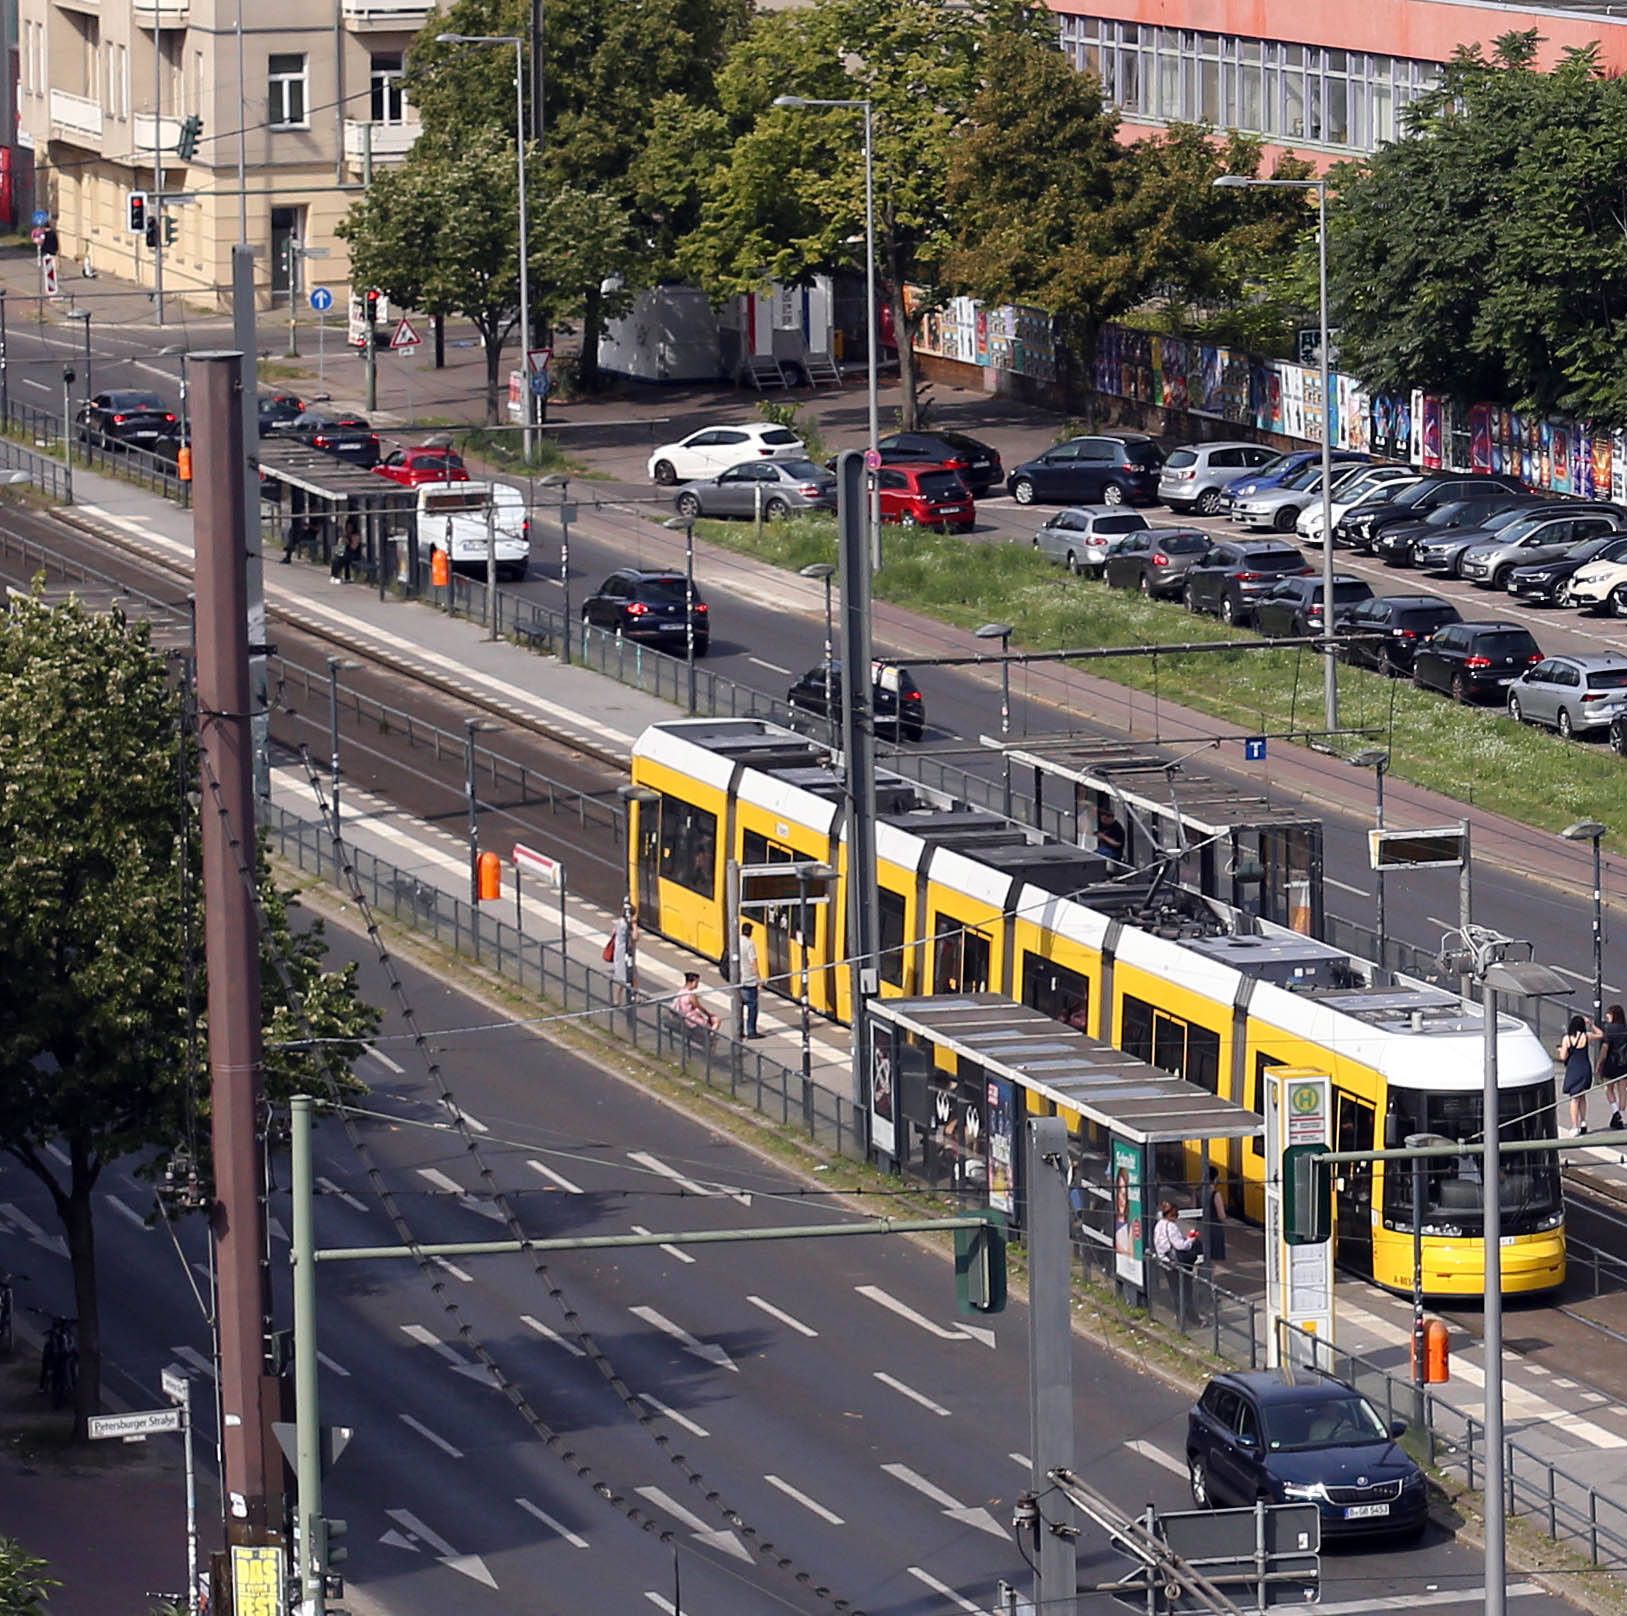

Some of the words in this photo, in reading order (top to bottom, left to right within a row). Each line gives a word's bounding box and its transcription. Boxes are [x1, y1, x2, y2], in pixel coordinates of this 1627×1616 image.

[95, 1419, 147, 1431] Petersburger
[148, 1414, 176, 1427] Straße
[237, 1559, 278, 1585] DAS
